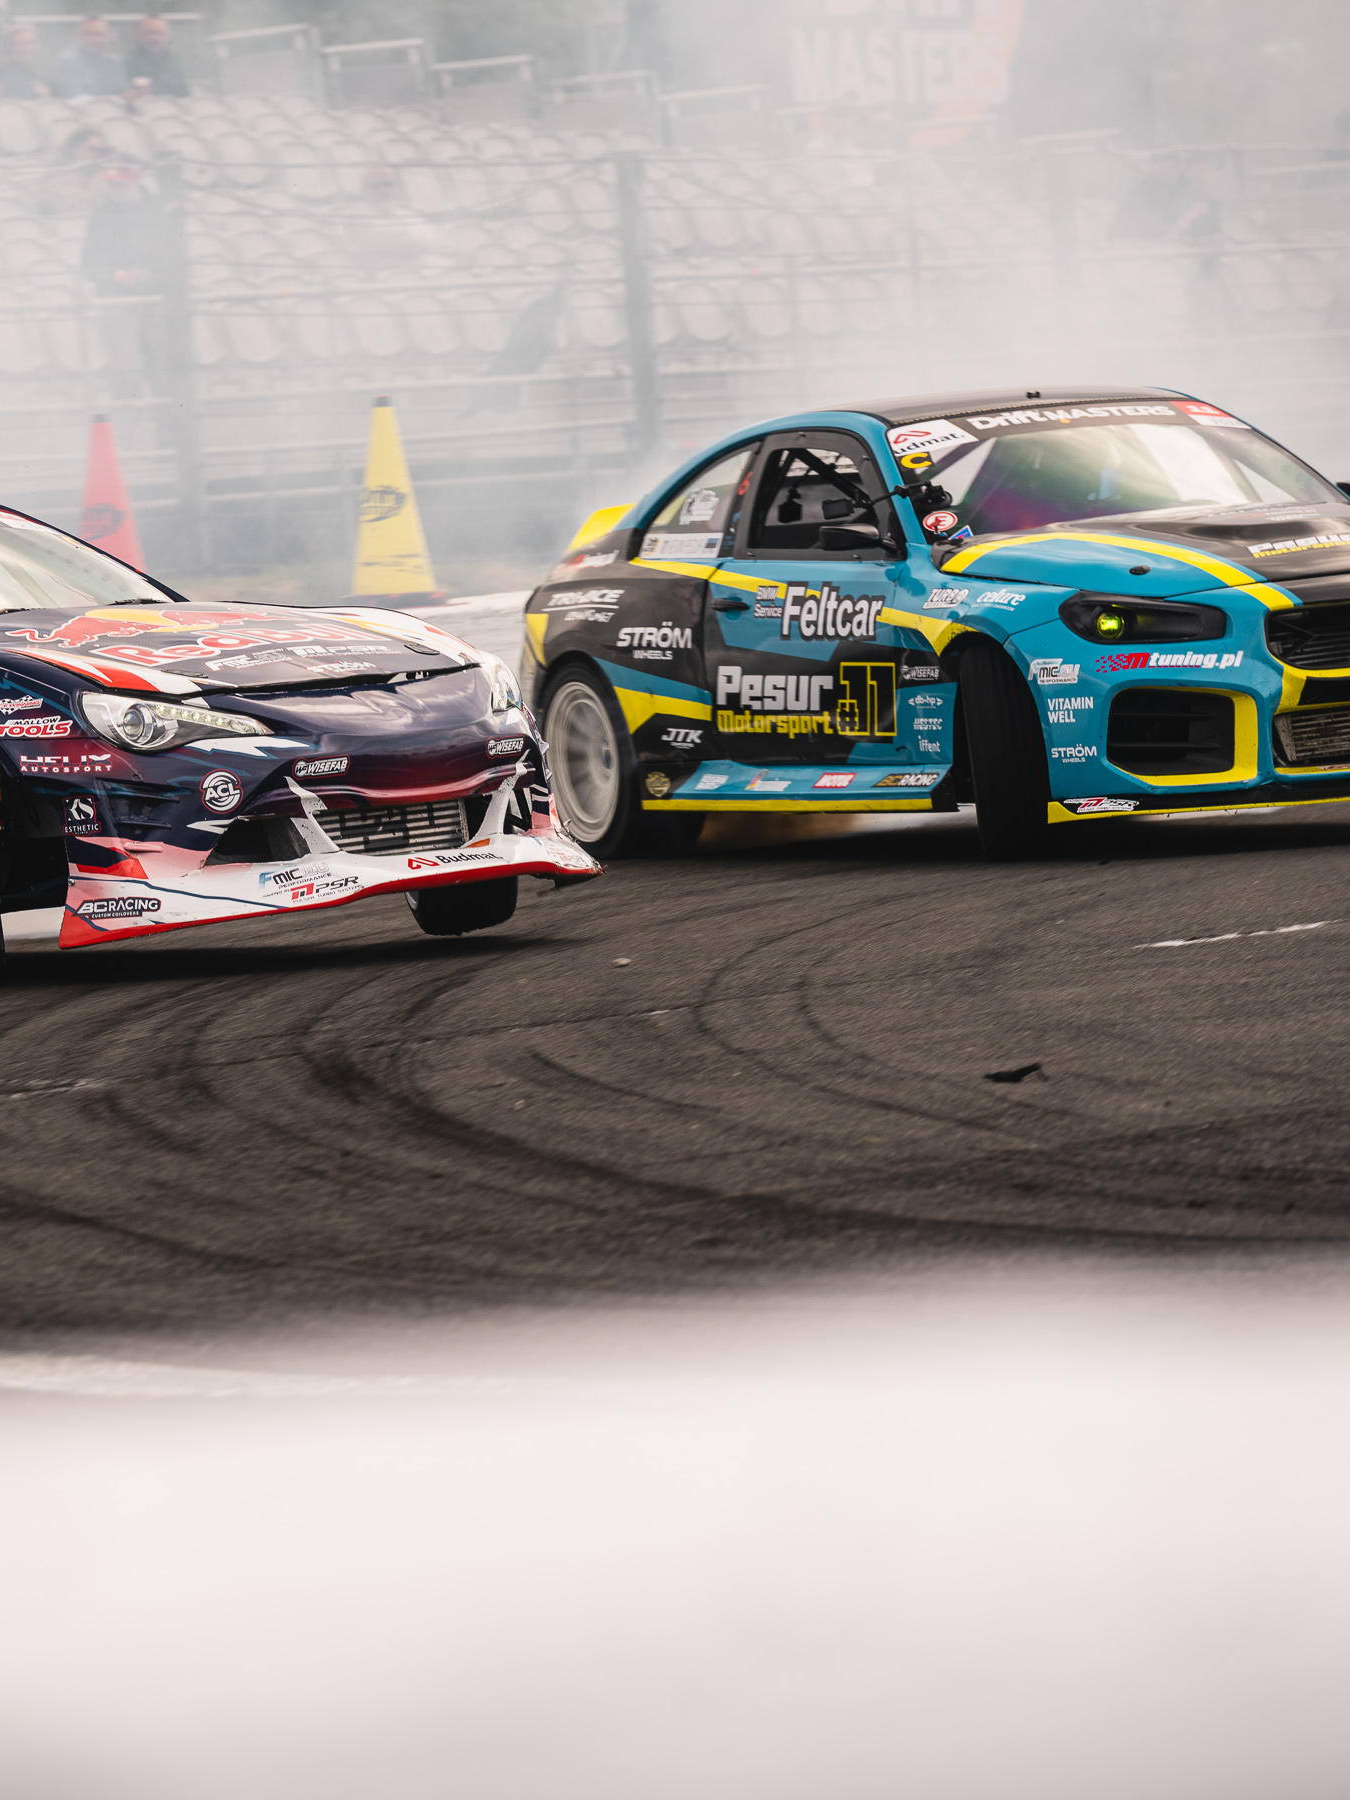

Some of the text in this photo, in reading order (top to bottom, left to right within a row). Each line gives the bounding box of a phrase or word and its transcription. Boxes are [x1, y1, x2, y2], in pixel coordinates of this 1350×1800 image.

[966, 409, 1048, 430] Drift
[1042, 406, 1177, 421] MASTERS
[894, 433, 965, 455] udmat.
[782, 586, 883, 637] Feltcar
[616, 621, 693, 648] STRÖM
[633, 650, 673, 660] WHEELS
[716, 665, 834, 711] Pesur
[1047, 696, 1094, 711] VITAMIN
[1047, 710, 1076, 723] WELL
[716, 710, 834, 740] Motorsport
[661, 728, 703, 743] JTK
[496, 741, 524, 752] WISEFAB
[1051, 743, 1097, 758] STRÖM
[20, 765, 112, 773] AUTOSPORT
[307, 760, 348, 774] WISEFAB
[205, 780, 240, 800] ACL
[64, 824, 99, 833] ESTHETIC
[278, 872, 332, 889] PERFORMANCE
[315, 876, 359, 893] PSR
